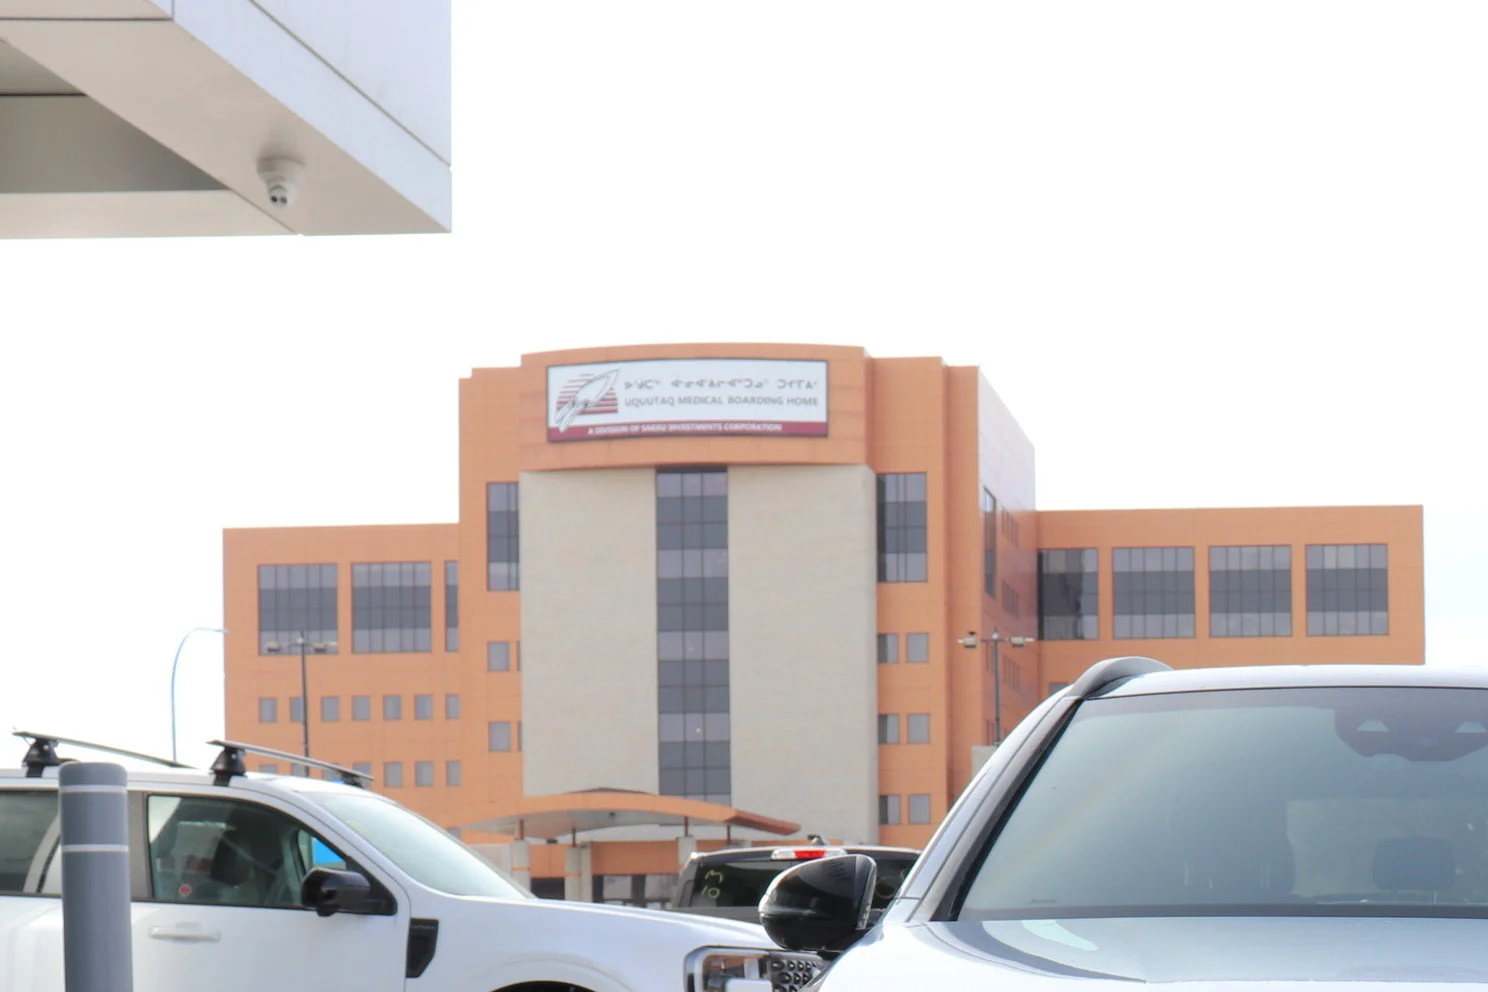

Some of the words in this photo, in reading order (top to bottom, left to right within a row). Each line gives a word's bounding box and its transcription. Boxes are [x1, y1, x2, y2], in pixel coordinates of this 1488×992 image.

[624, 396, 676, 408] UQUUTAQ
[677, 395, 722, 405] MEDICAL
[727, 395, 784, 405] BOARDING
[786, 396, 818, 406] HOME
